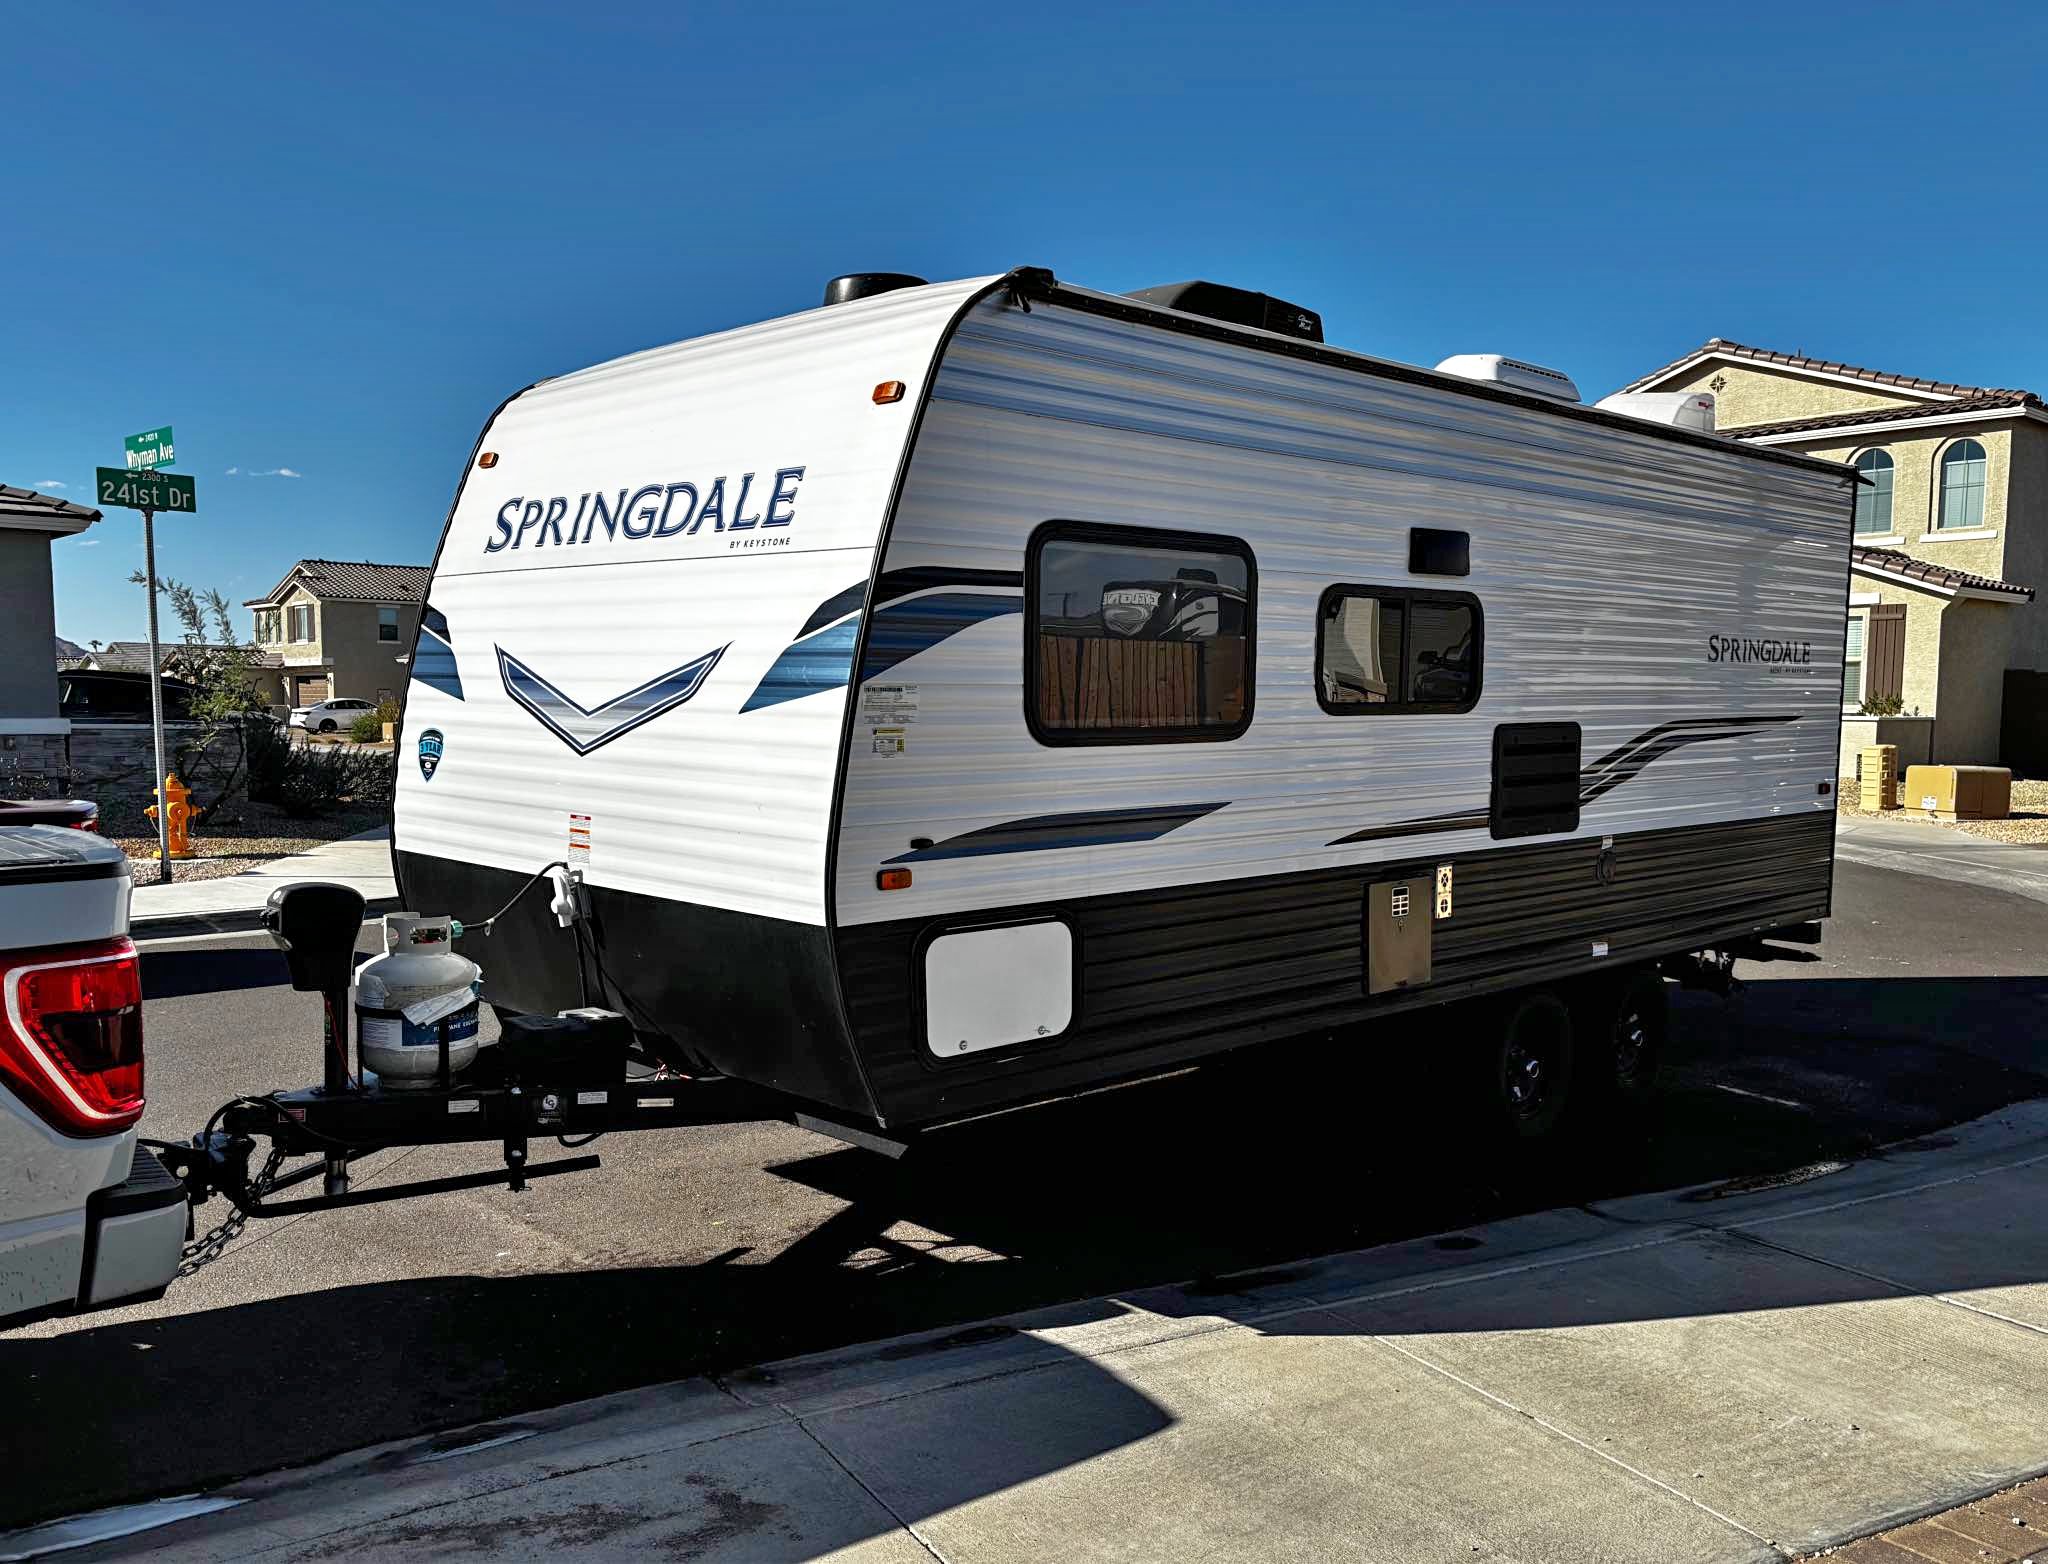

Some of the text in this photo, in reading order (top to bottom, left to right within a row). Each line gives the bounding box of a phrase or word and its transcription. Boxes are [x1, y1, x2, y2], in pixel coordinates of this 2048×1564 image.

[126, 443, 174, 471] Whyman Ave
[102, 480, 191, 508] 241st Dr
[484, 466, 806, 553] SPRINGDALE
[730, 537, 791, 549] BY KEYSTONE
[1708, 634, 1811, 664] SPRINGDALE
